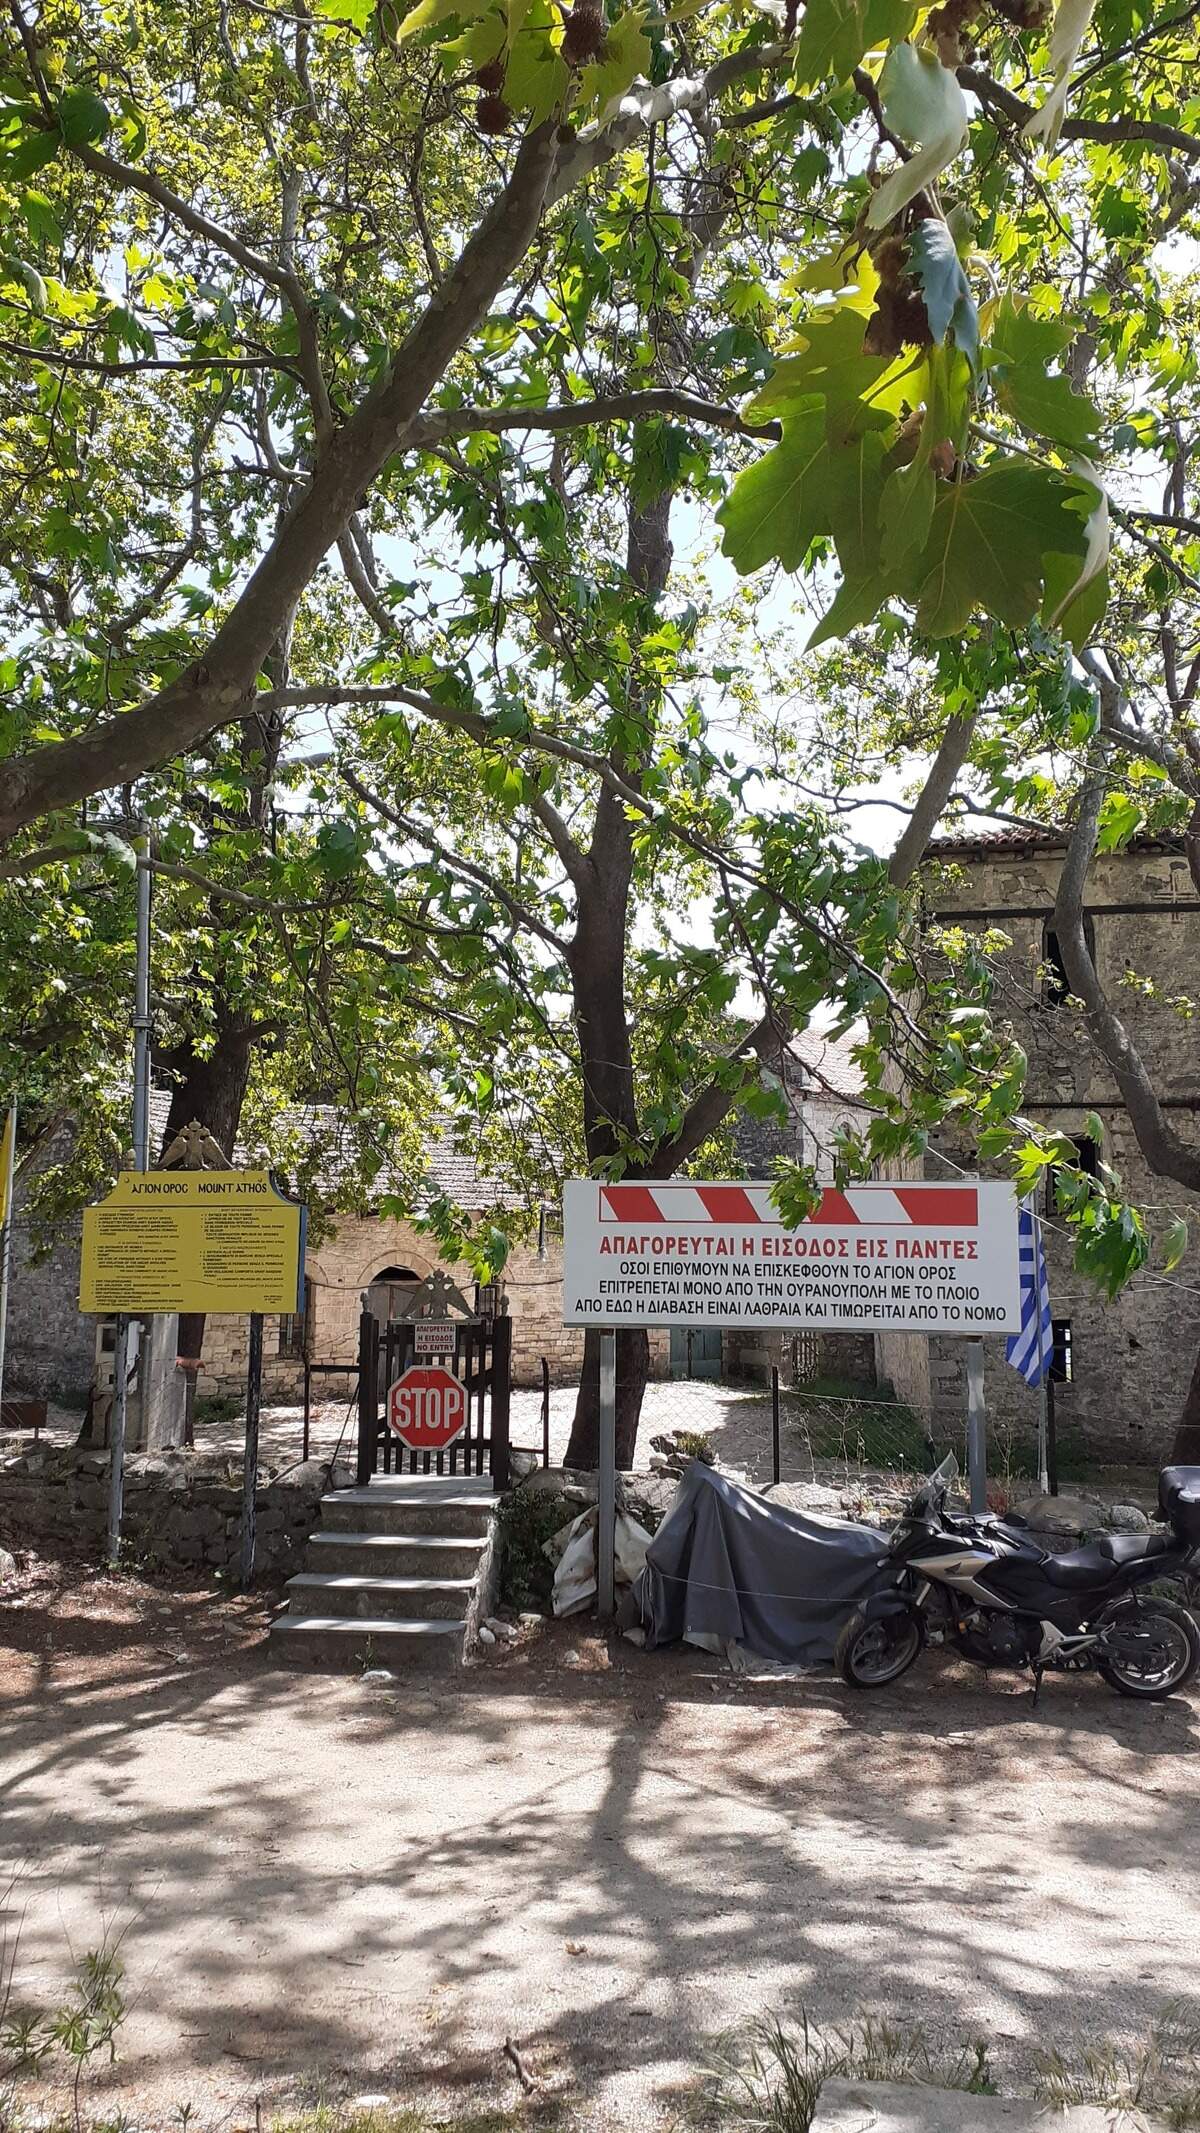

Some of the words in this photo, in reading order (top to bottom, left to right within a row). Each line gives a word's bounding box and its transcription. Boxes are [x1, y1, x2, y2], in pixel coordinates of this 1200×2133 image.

[131, 1183, 161, 1194] ΑΓΙΟΝ
[198, 1183, 234, 1194] MOUNT
[235, 1182, 267, 1194] ATHOS
[600, 1237, 734, 1255] ΑΠΑΓΟΡΕΥΤΑΙ
[743, 1238, 754, 1255] Η
[762, 1238, 848, 1257] ΕΙΣΟΔΟΣ
[857, 1240, 888, 1257] ΕΙΣ
[896, 1240, 977, 1259] ΠΑΝΤΕΣ
[620, 1262, 649, 1274] ΟΣΟΙ
[654, 1262, 728, 1276] ΕΠΙΘΥΜΟΥΝ
[733, 1264, 750, 1276] ΝΑ
[755, 1264, 848, 1278] ΕΠΙΣΚΕΦΘΟΥΝ
[853, 1265, 870, 1278] ΤΟ
[874, 1266, 914, 1279] ΑΓΙΟΝ
[919, 1266, 955, 1280] ΟΡΟΣ
[600, 1281, 679, 1294] ΕΠΙΤΡΕΠΕΤΑΙ
[684, 1282, 722, 1295] ΜΟΝΟ
[725, 1282, 753, 1295] ΑΠΟ
[757, 1283, 782, 1296] ΤΗΝ
[787, 1283, 886, 1298] ΟΥΡΑΝΟΥΠΟΛΗ
[892, 1286, 910, 1299] ΜΕ
[915, 1286, 932, 1299] ΤΟ
[937, 1287, 979, 1300] ΠΛΟΙΟ
[575, 1299, 602, 1312] ΑΠΟ
[606, 1299, 632, 1312] ΕΔΩ
[637, 1300, 644, 1312] Η
[648, 1300, 703, 1314] ΔΙΑΒΑΣΗ
[708, 1301, 740, 1314] ΕΙΝΑΙ
[745, 1302, 801, 1316] ΛΑΘΡΑΙΑ
[806, 1303, 826, 1316] ΚΑΙ
[831, 1304, 904, 1318] ΤΙΜΩΡΕΙΤΑΙ
[909, 1305, 937, 1319] ΑΠΟ
[942, 1306, 960, 1319] ΤΟ
[965, 1307, 1006, 1320] ΝΟΜΟ
[395, 1387, 460, 1429] STOP
